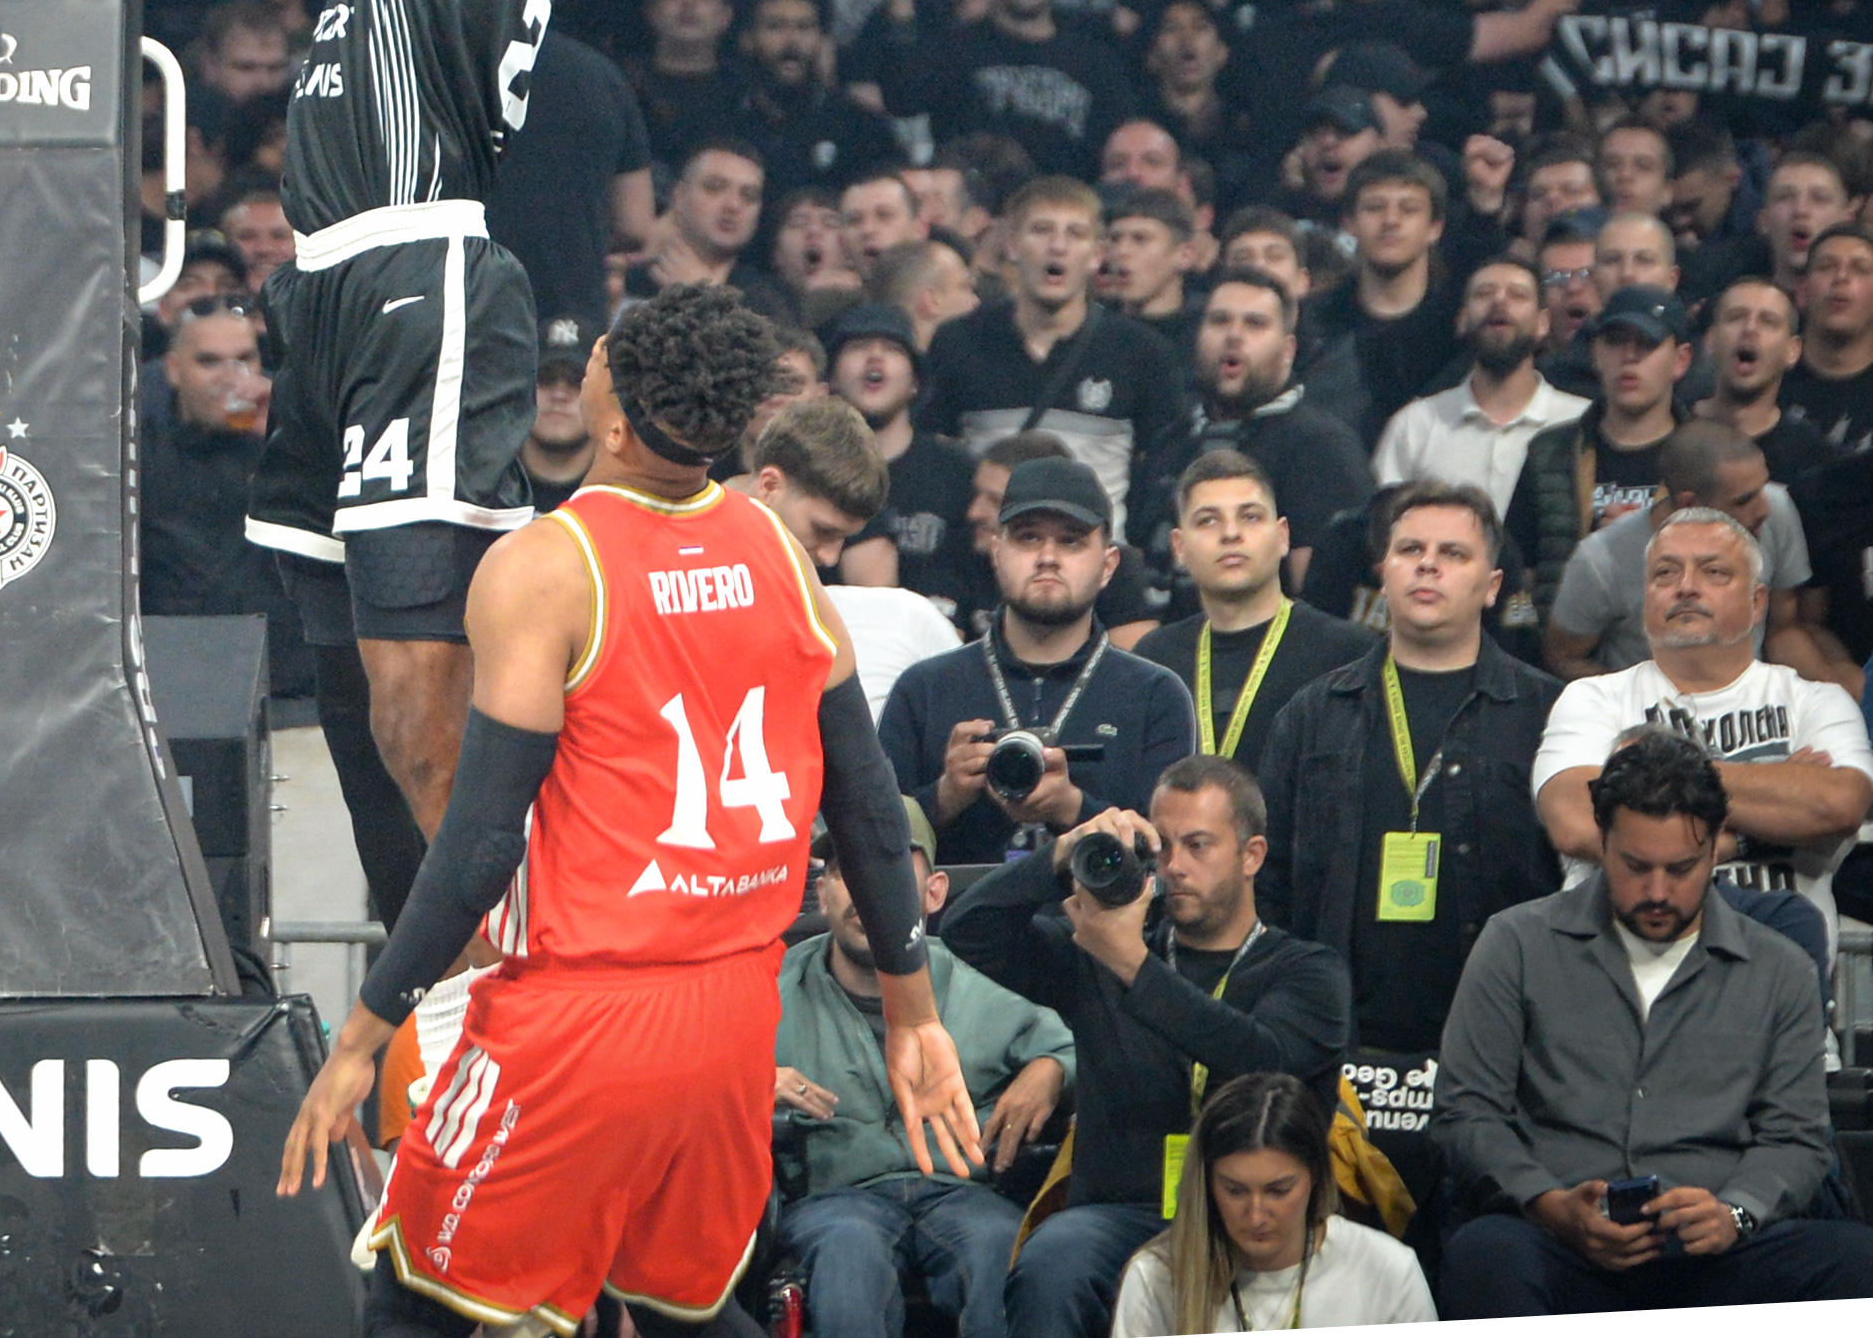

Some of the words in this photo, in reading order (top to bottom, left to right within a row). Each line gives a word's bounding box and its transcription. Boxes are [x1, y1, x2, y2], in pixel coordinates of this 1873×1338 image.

[337, 416, 415, 499] 24
[11, 465, 48, 572] ПАРТИЗАН
[648, 563, 755, 615] RIVERO
[656, 684, 797, 850] 14
